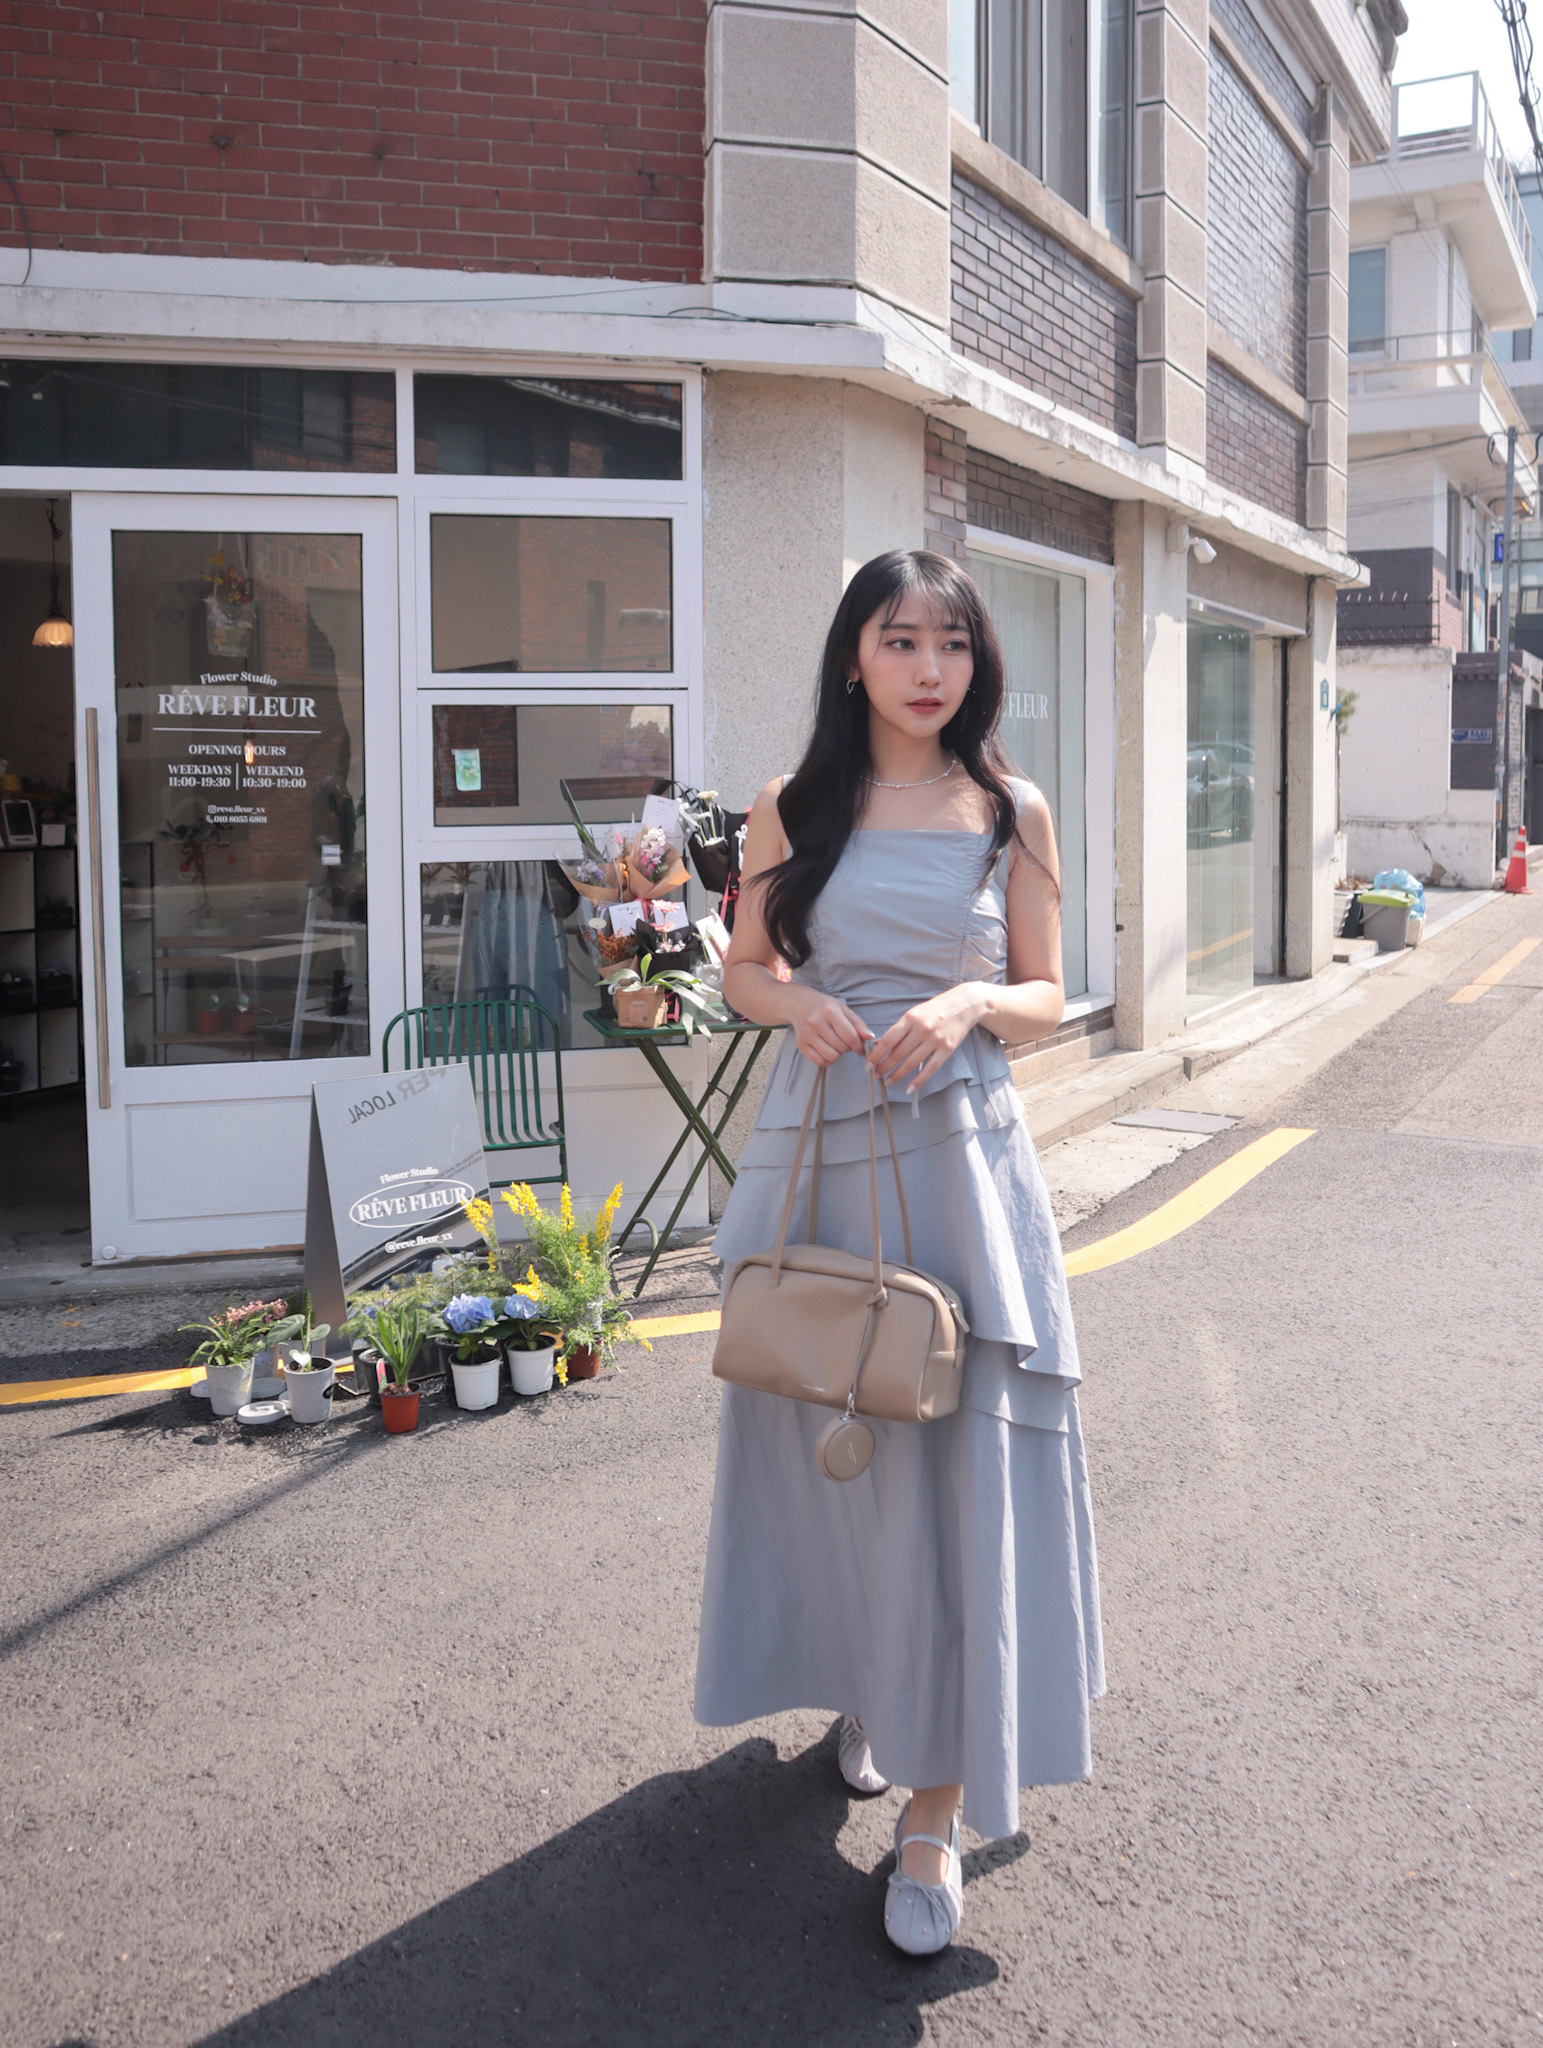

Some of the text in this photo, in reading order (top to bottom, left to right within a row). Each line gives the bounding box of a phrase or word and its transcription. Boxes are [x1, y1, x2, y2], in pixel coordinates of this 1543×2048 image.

[200, 671, 278, 687] Flower Studio
[157, 688, 317, 718] RÊVE FLEUR
[1009, 692, 1049, 719] FLEUR
[188, 744, 242, 756] OPENING
[168, 764, 304, 777] WEEKDAYS WEEKEND
[168, 776, 307, 789] 11:00-19:30 10:30-19:00
[213, 815, 228, 823] 010
[380, 1166, 439, 1185] Flower Studio
[356, 1186, 468, 1221] RÊVE FLEUR
[384, 1232, 454, 1254] @reve.fleur_xx
